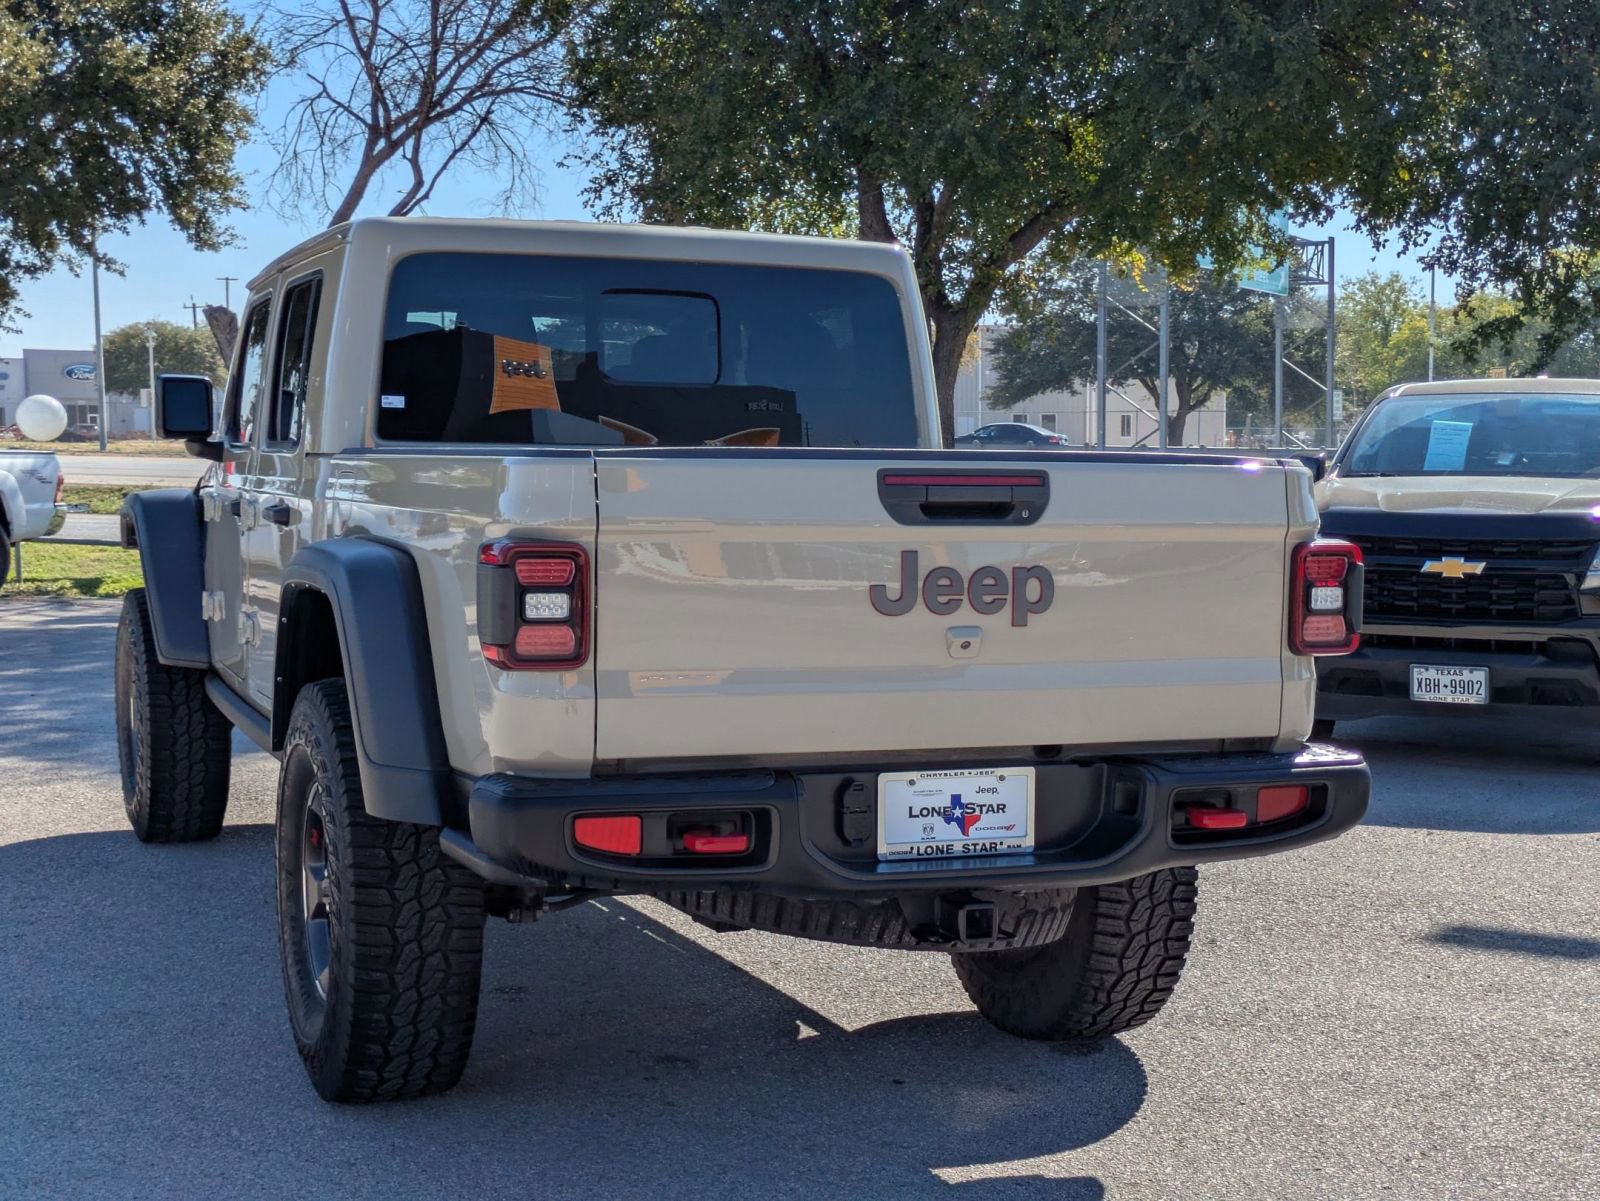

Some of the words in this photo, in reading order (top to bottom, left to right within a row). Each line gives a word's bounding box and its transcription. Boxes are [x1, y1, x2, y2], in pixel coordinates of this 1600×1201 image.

[869, 550, 1055, 627] Jeep
[1435, 669, 1464, 677] TEXAS
[975, 785, 998, 795] Jeep
[908, 806, 952, 818] LONE
[964, 802, 1007, 815] STAR
